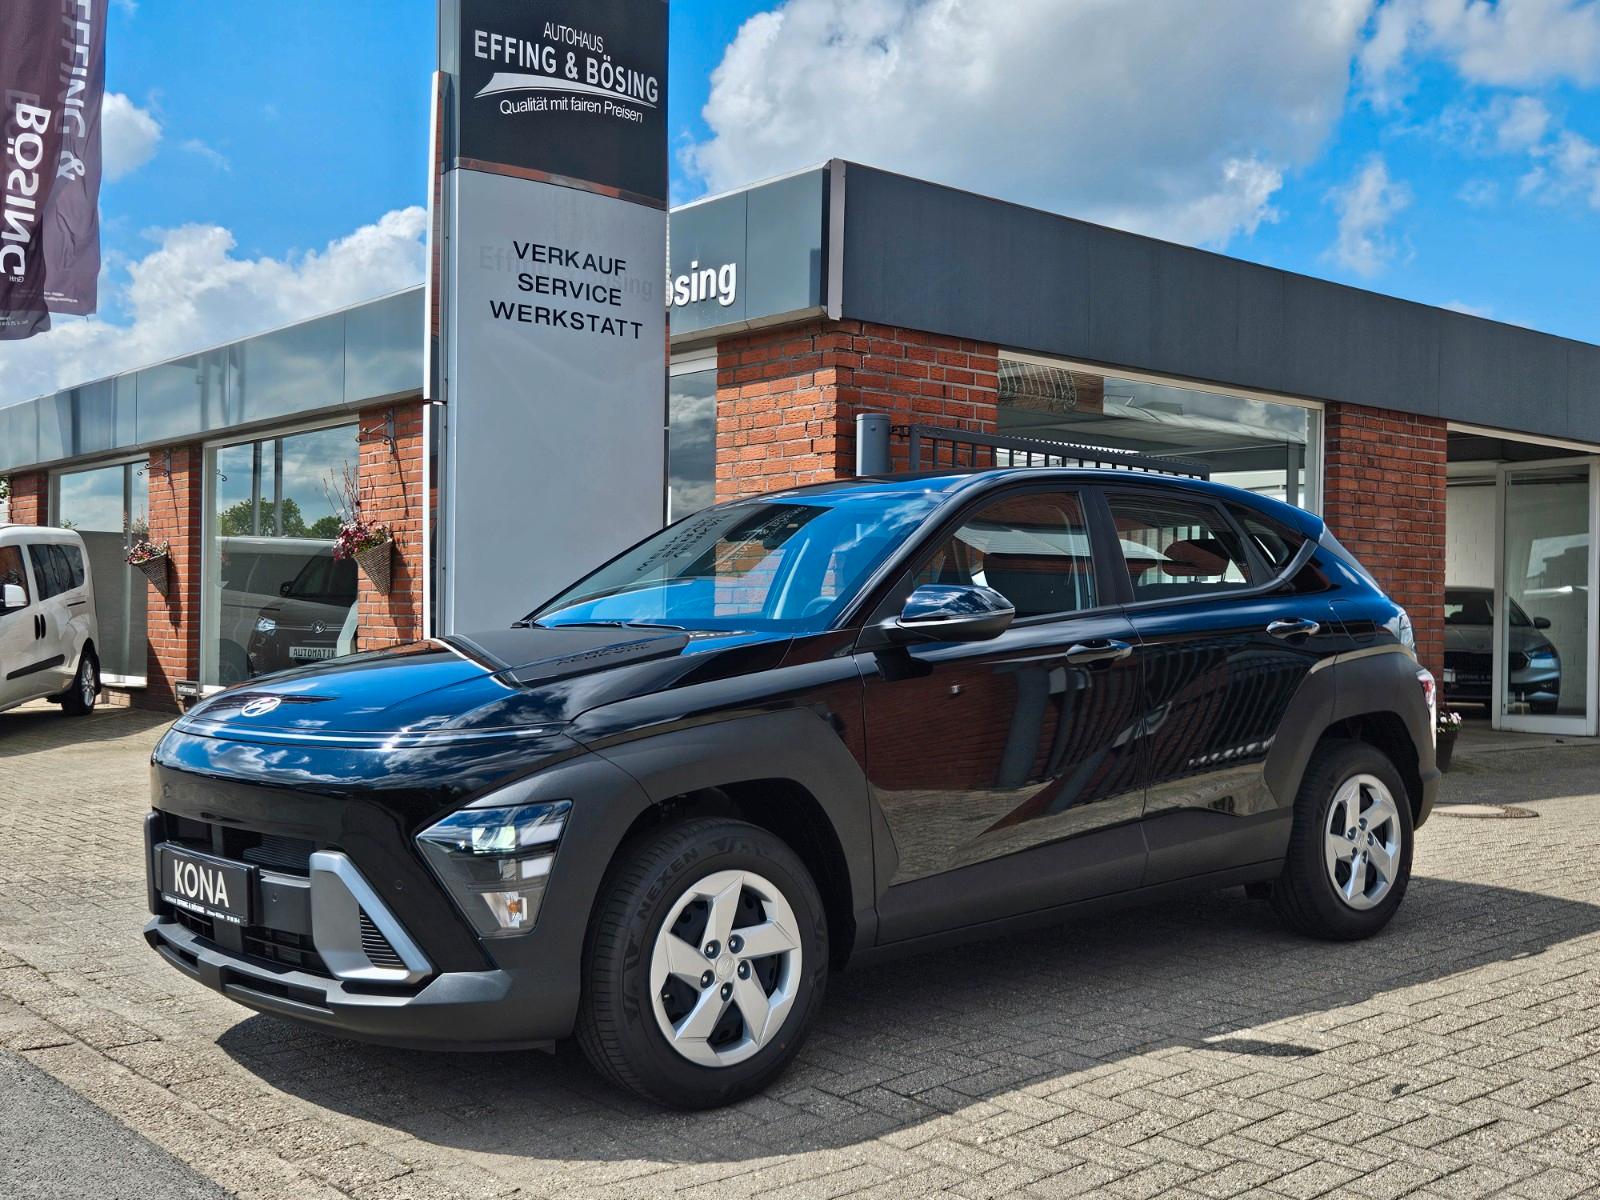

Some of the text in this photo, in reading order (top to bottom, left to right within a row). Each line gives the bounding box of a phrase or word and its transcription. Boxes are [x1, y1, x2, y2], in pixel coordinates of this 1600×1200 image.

[543, 21, 604, 53] AUTOHAUS
[474, 29, 659, 103] EFFING & BÖSING
[500, 96, 643, 123] Qualität mit fairen Preisen
[513, 240, 627, 276] VERKAUF
[517, 273, 622, 307] SERVICE
[489, 300, 643, 339] WERKSTATT
[293, 648, 336, 659] AUTOMATIK
[174, 859, 230, 908] KONA
